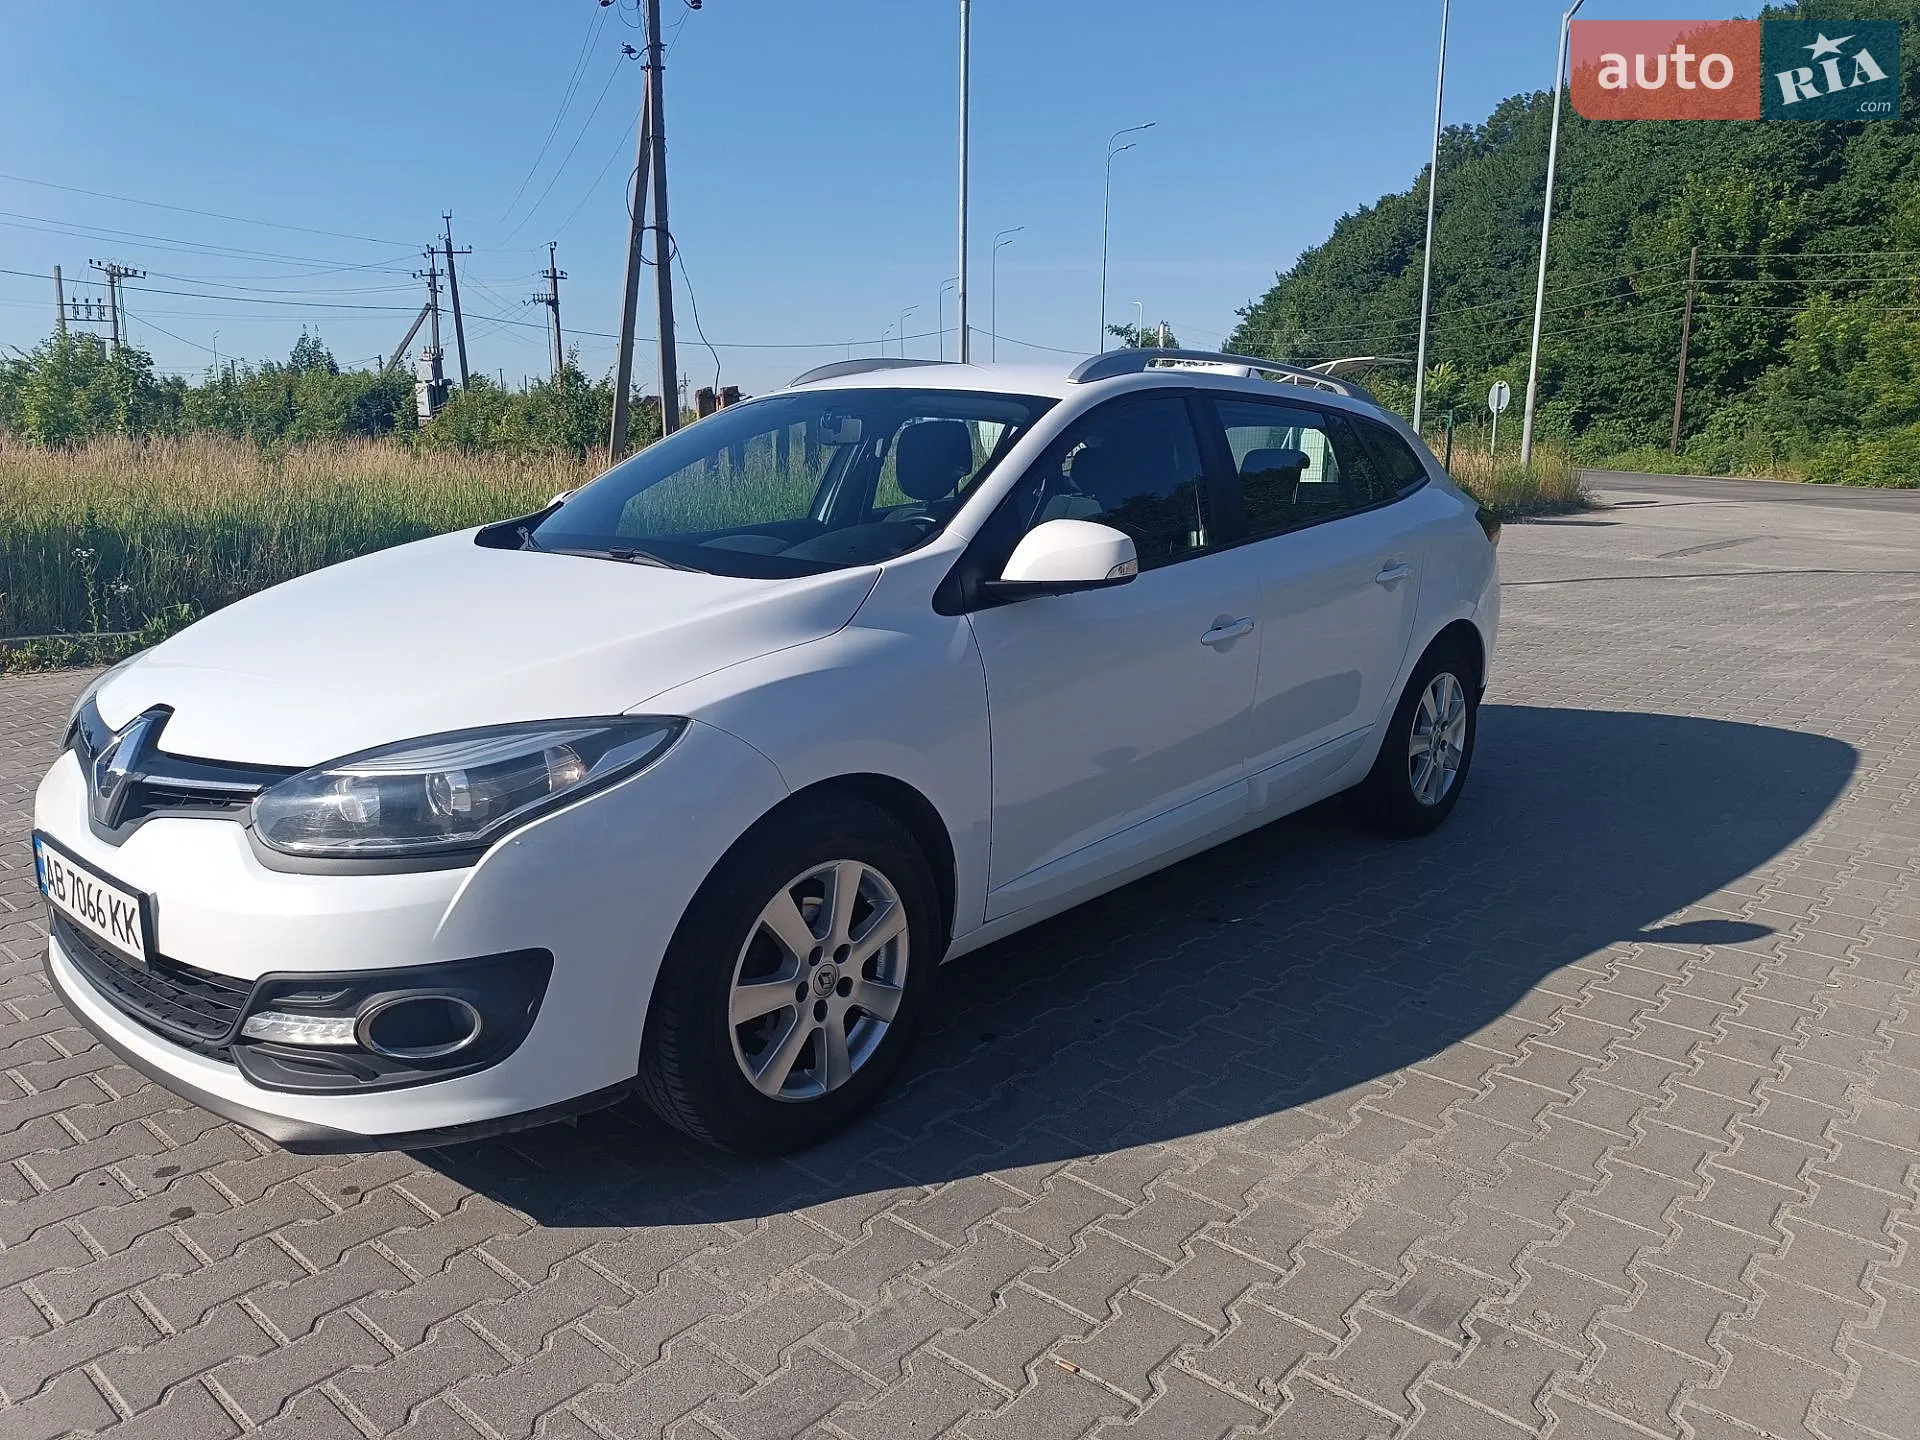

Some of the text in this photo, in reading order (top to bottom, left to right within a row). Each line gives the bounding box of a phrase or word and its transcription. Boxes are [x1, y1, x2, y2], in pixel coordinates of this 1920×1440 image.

[46, 855, 141, 950] AB 7066 KK
